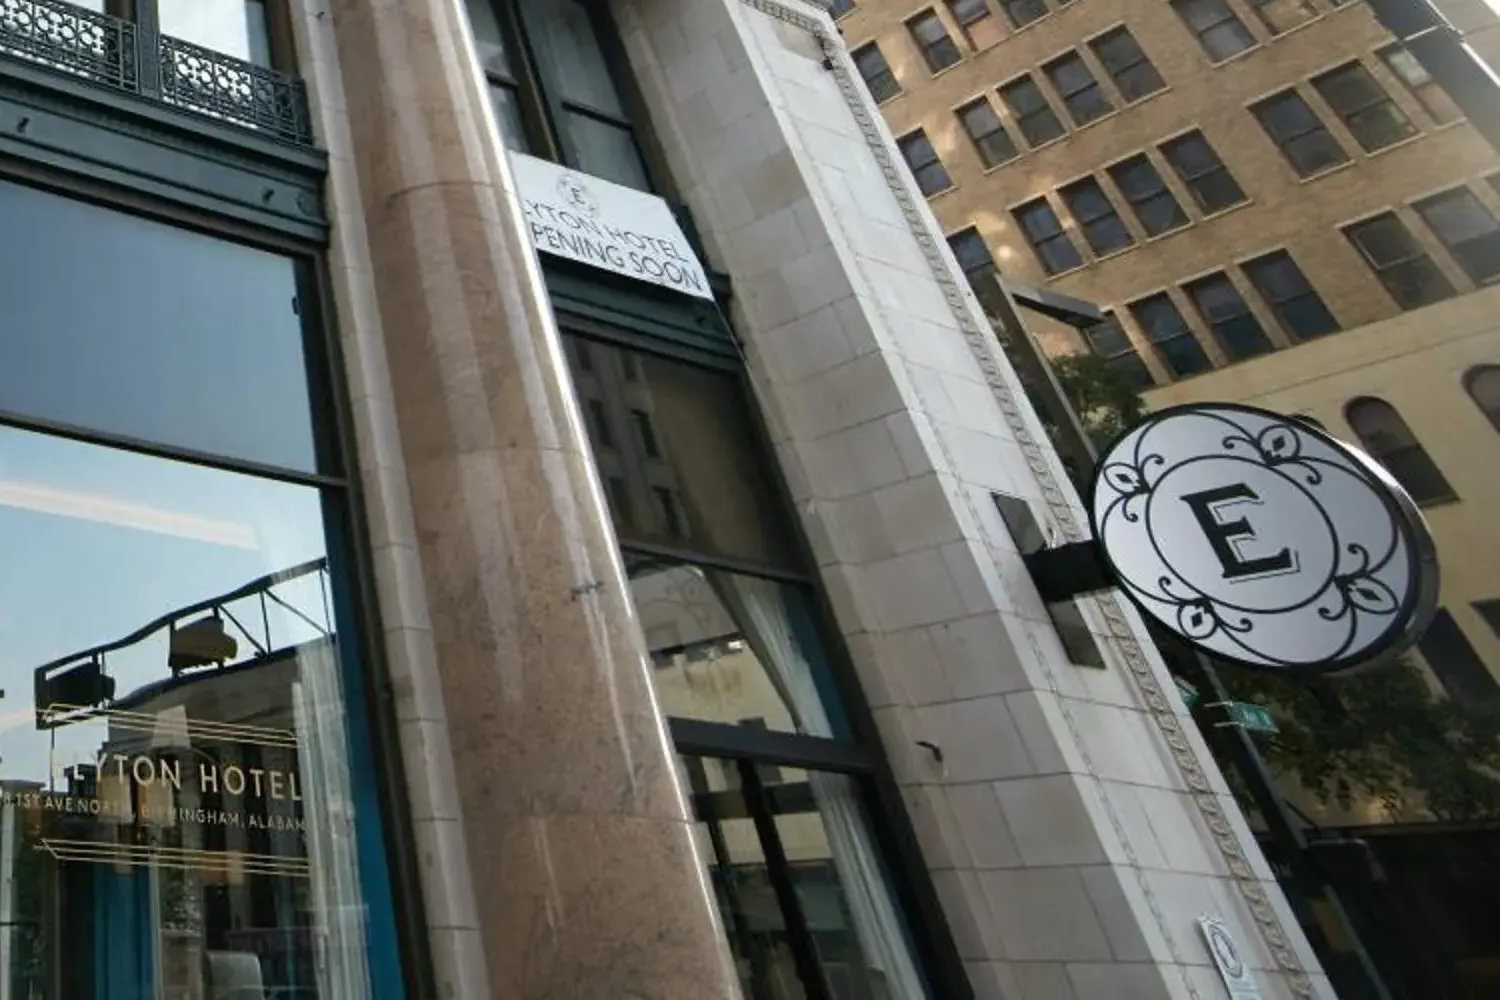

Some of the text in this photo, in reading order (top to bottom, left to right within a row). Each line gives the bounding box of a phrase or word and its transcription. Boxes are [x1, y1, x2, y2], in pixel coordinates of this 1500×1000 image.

[530, 220, 705, 292] PENING SOON
[603, 222, 690, 263] HOTEL
[1179, 482, 1300, 584] E
[200, 762, 302, 801] HOTEL
[44, 795, 74, 813] AVE
